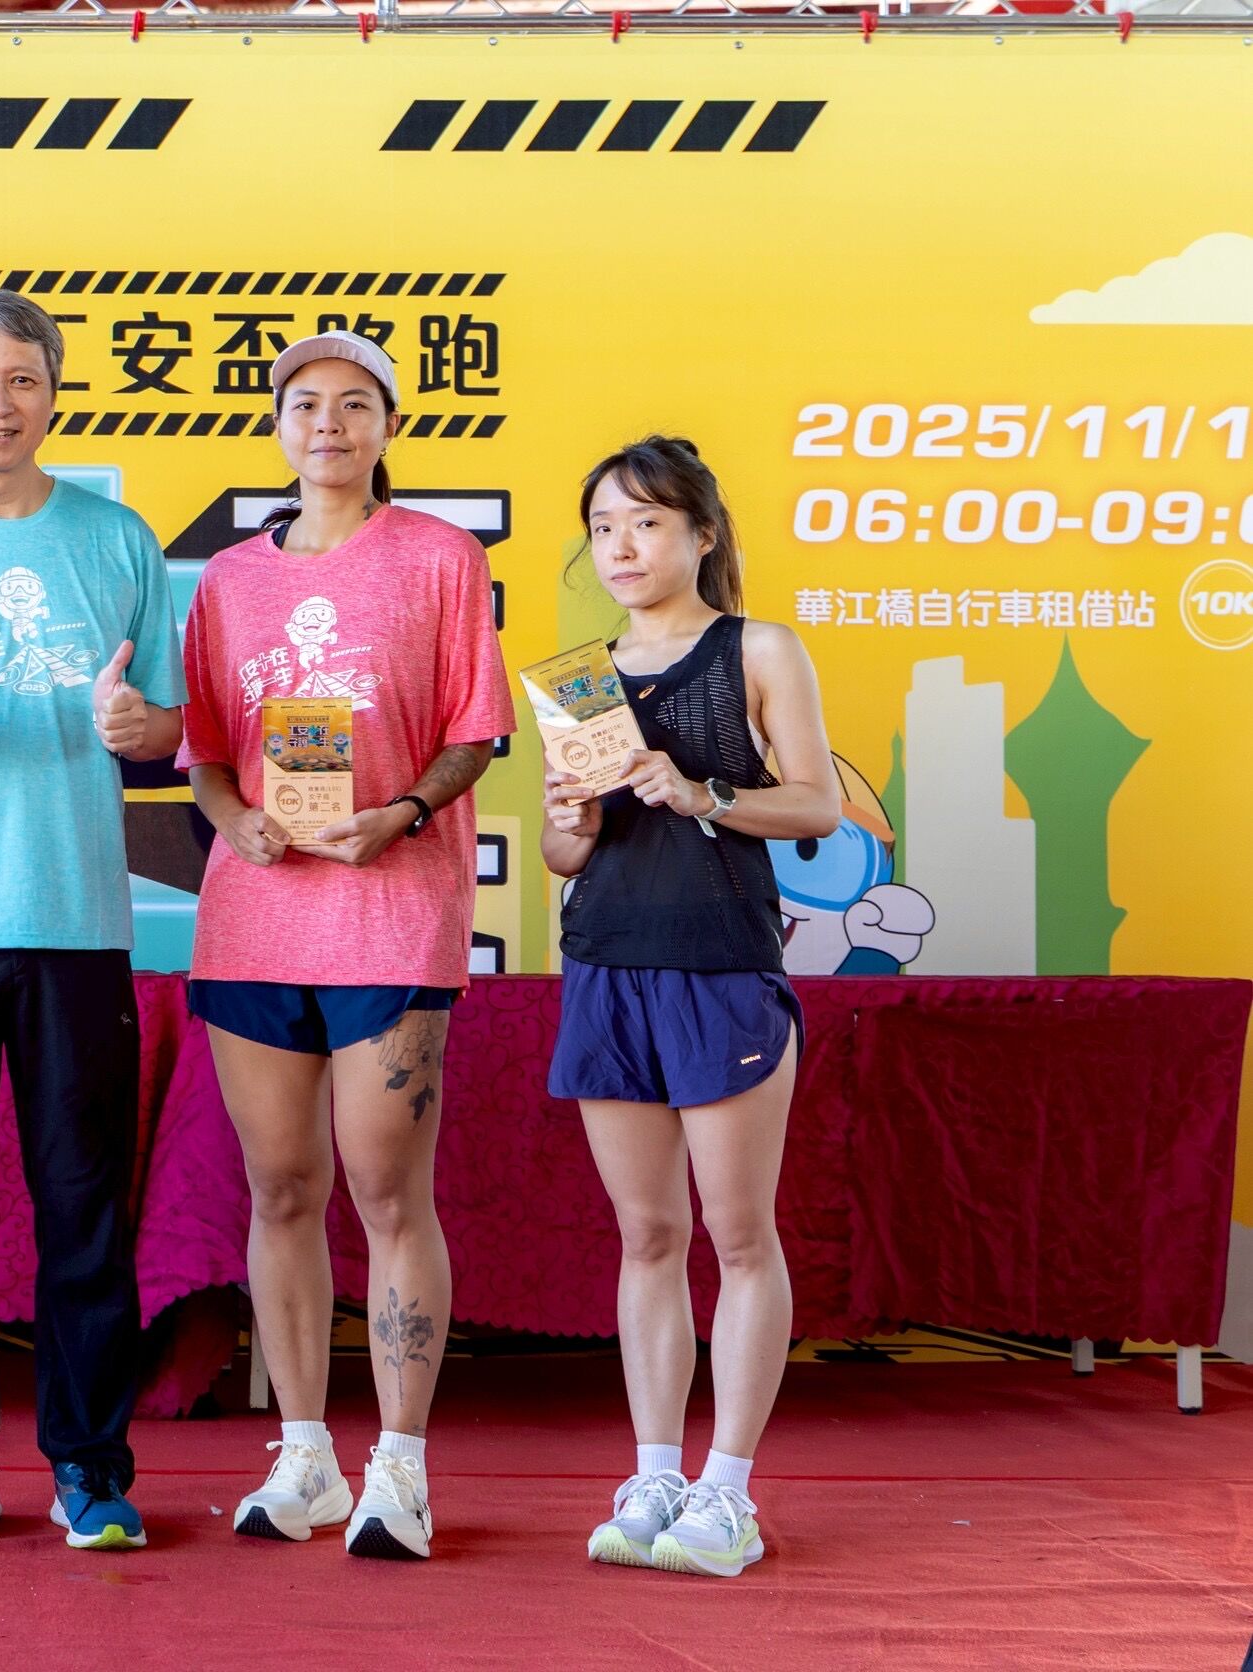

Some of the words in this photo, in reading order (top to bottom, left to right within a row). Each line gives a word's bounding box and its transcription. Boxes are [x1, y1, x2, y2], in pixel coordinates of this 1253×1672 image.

[794, 587, 1157, 629] 華江橋自行車租借站
[1190, 590, 1253, 616] 10K
[18, 683, 46, 692] 2025
[568, 749, 588, 763] 10K
[279, 797, 299, 806] 10K
